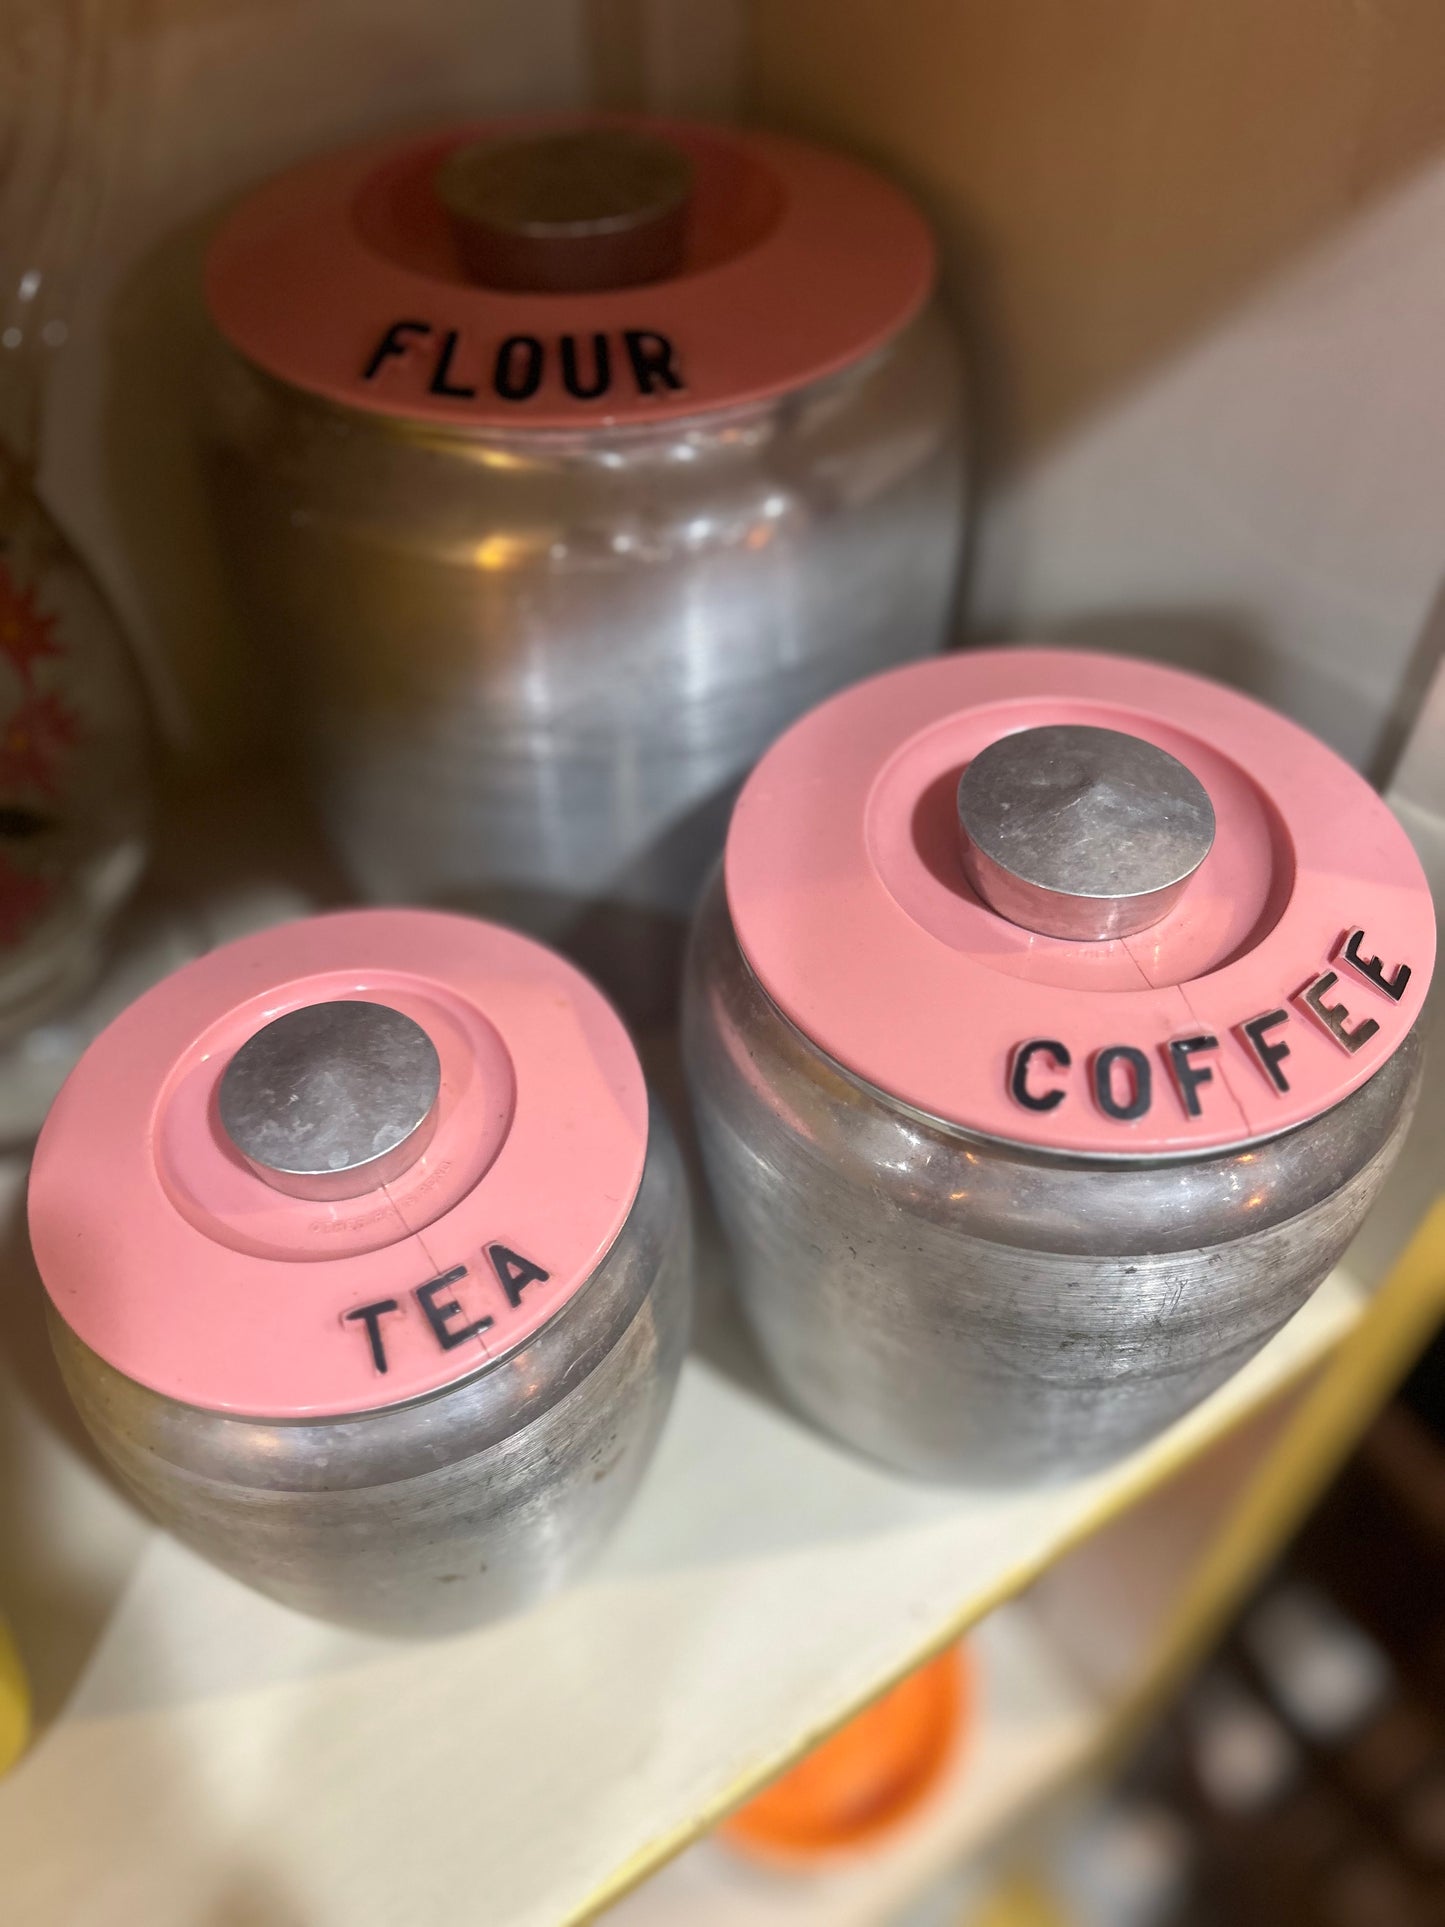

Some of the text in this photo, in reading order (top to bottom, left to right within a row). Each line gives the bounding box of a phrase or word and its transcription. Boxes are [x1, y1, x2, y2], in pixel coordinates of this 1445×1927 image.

[363, 320, 686, 400] FLOUR
[1009, 925, 1412, 1121] COFFEE
[342, 1241, 550, 1376] TEA
